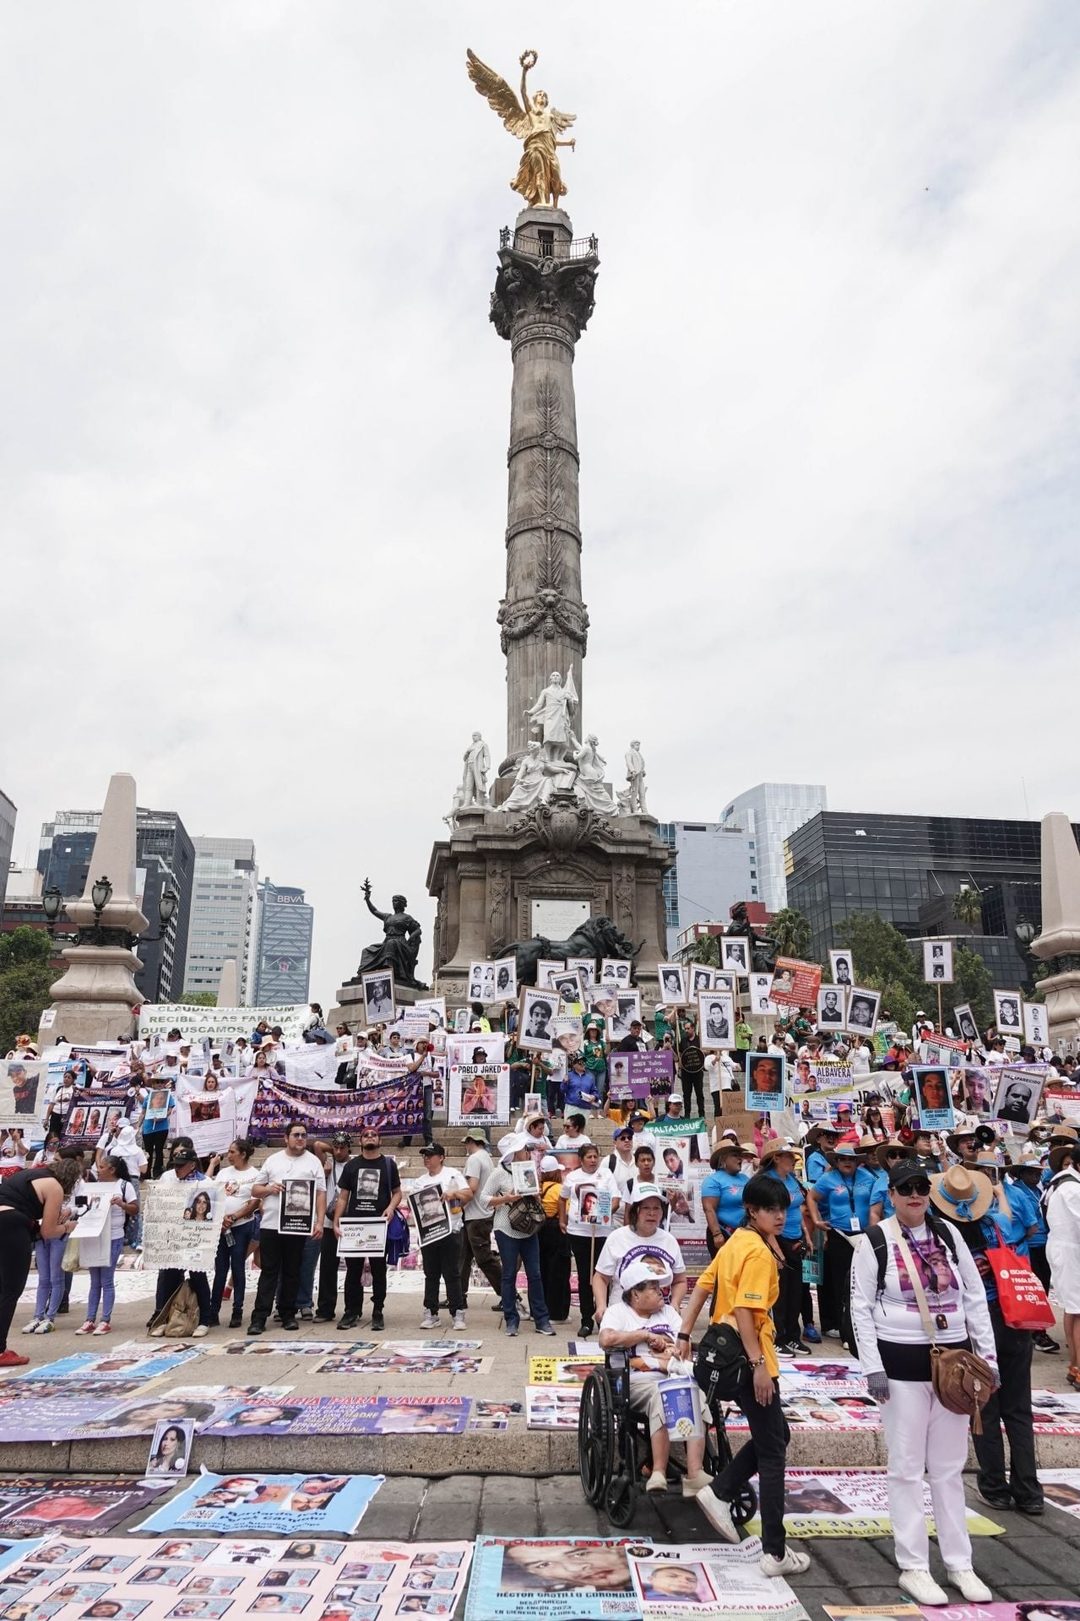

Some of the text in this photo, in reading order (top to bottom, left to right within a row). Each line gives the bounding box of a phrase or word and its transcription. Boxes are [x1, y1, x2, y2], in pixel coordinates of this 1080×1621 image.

[277, 895, 304, 904] BBVA
[141, 1027, 167, 1035] QUE
[817, 1067, 851, 1078] ALBAVERA
[329, 1396, 378, 1405] PARA
[387, 1396, 463, 1404] SANDRA
[692, 1604, 754, 1612] BALTAZAR
